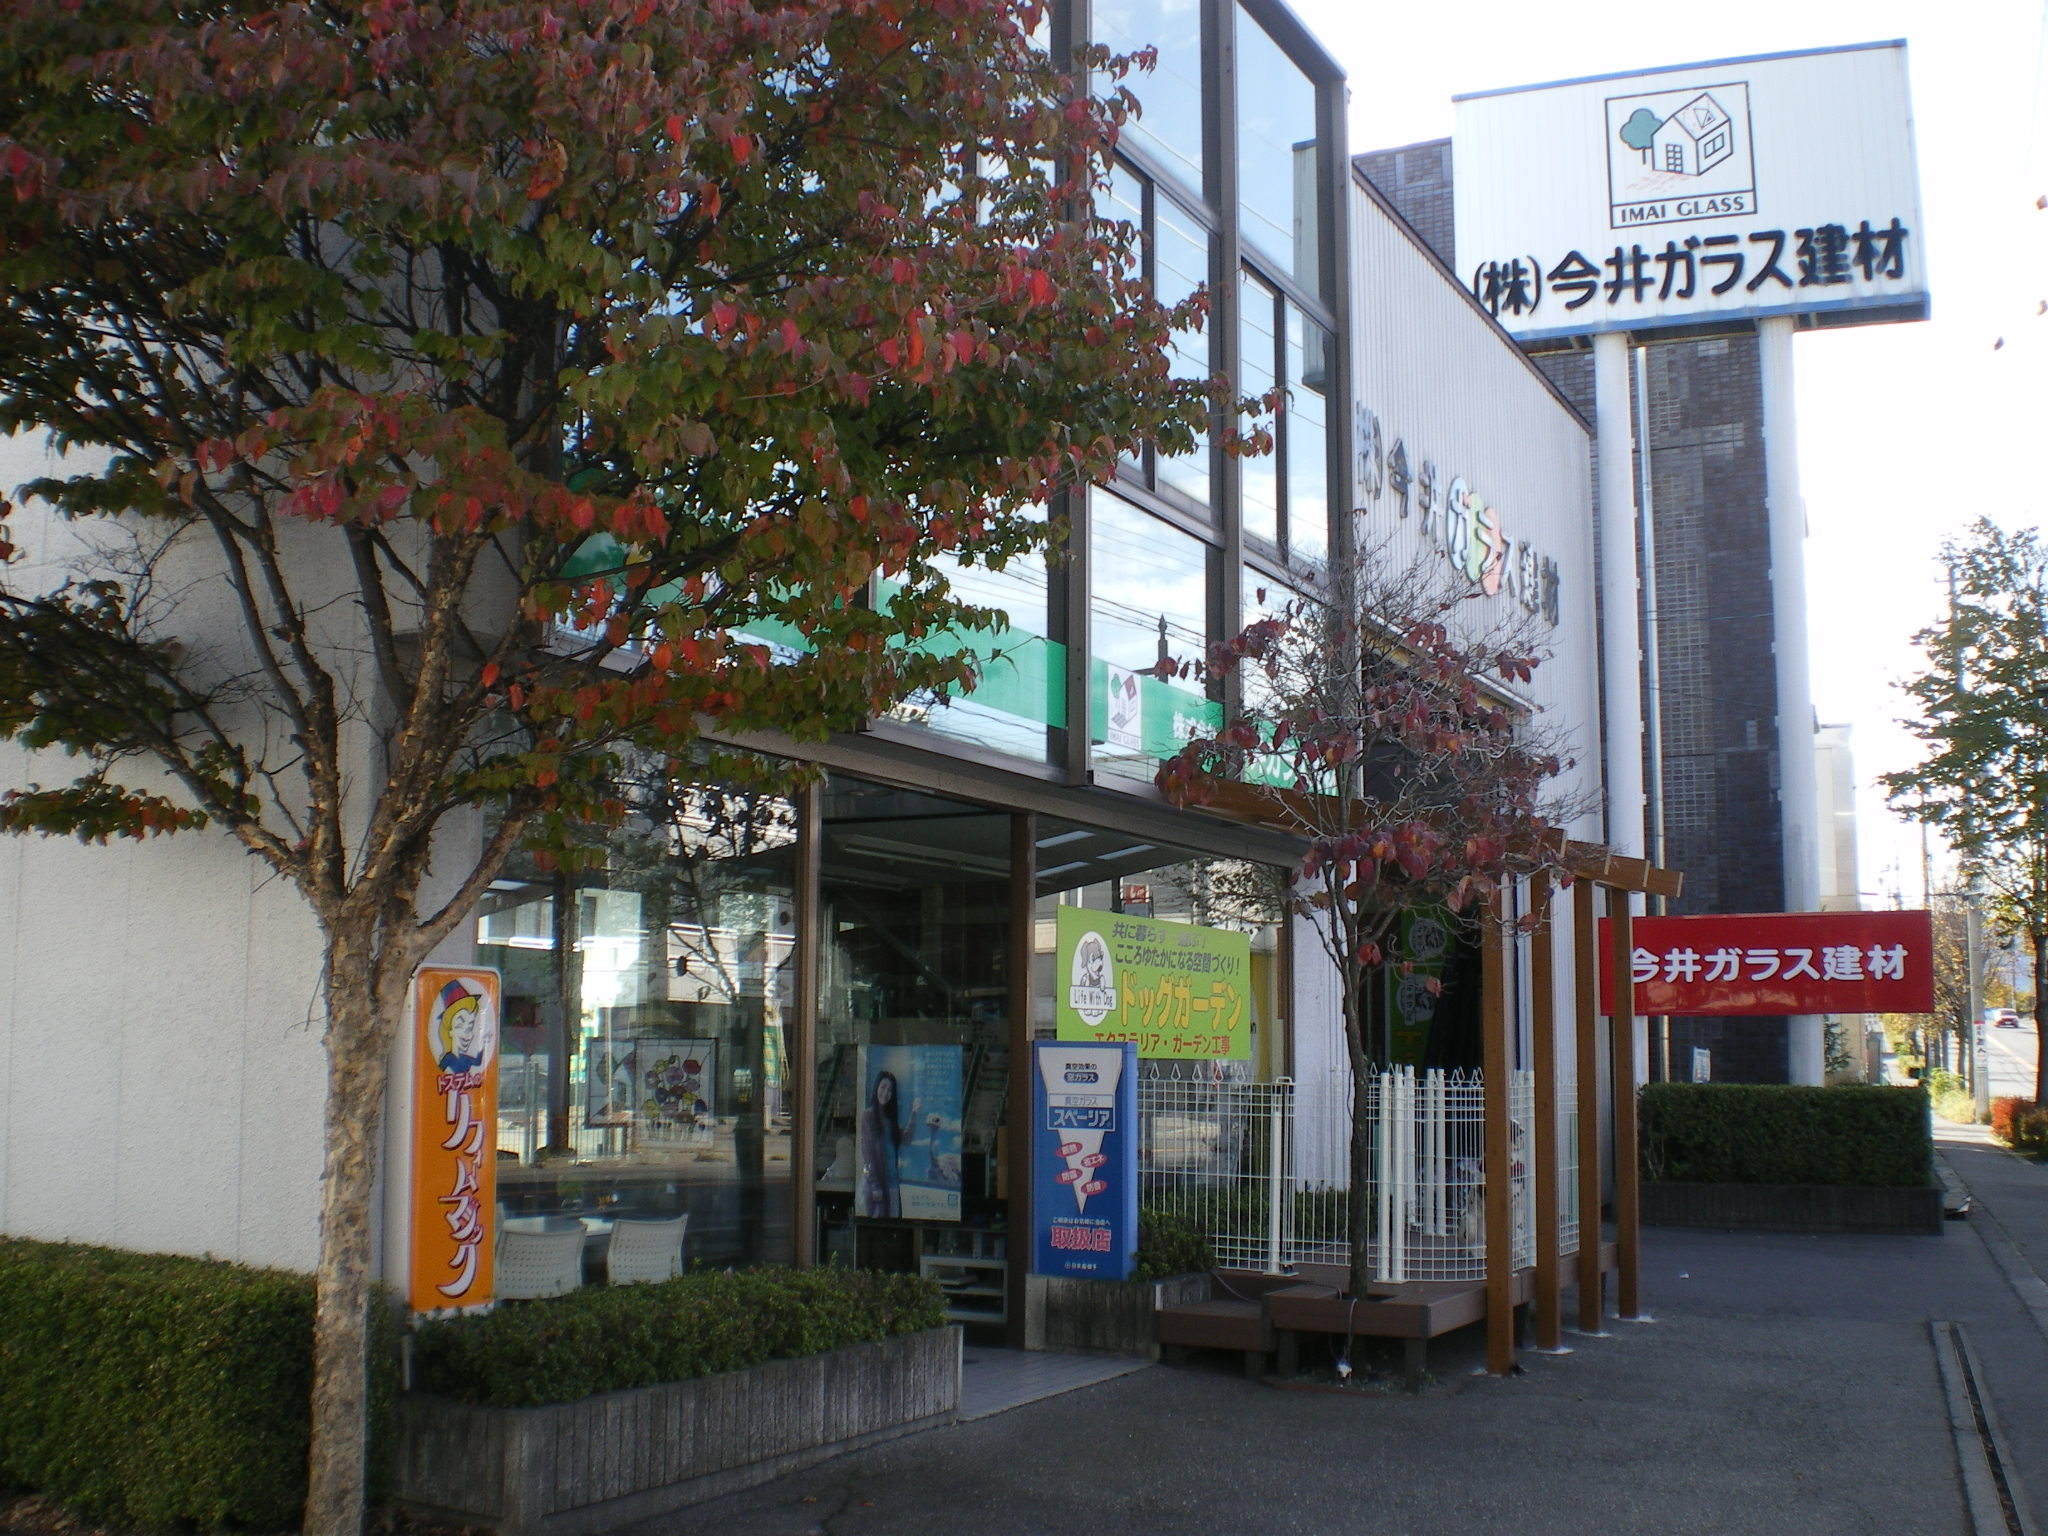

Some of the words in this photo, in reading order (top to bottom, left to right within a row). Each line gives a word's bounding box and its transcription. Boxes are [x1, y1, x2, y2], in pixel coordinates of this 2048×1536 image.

[1620, 204, 1666, 224] IMAI
[1677, 196, 1745, 216] GLASS
[1473, 216, 1909, 316] (株)今井ガラス建材
[1124, 734, 1140, 749] GLASS
[1632, 944, 1908, 983] 今井ガラス建材
[1121, 969, 1243, 1031] ドッグガーデン
[436, 1072, 482, 1095] トステムの
[1064, 1096, 1098, 1106] 真空ガラス
[1053, 1109, 1110, 1127] スペーシア
[435, 1088, 484, 1298] リフォームマジック
[1051, 1225, 1112, 1252] 取扱店
